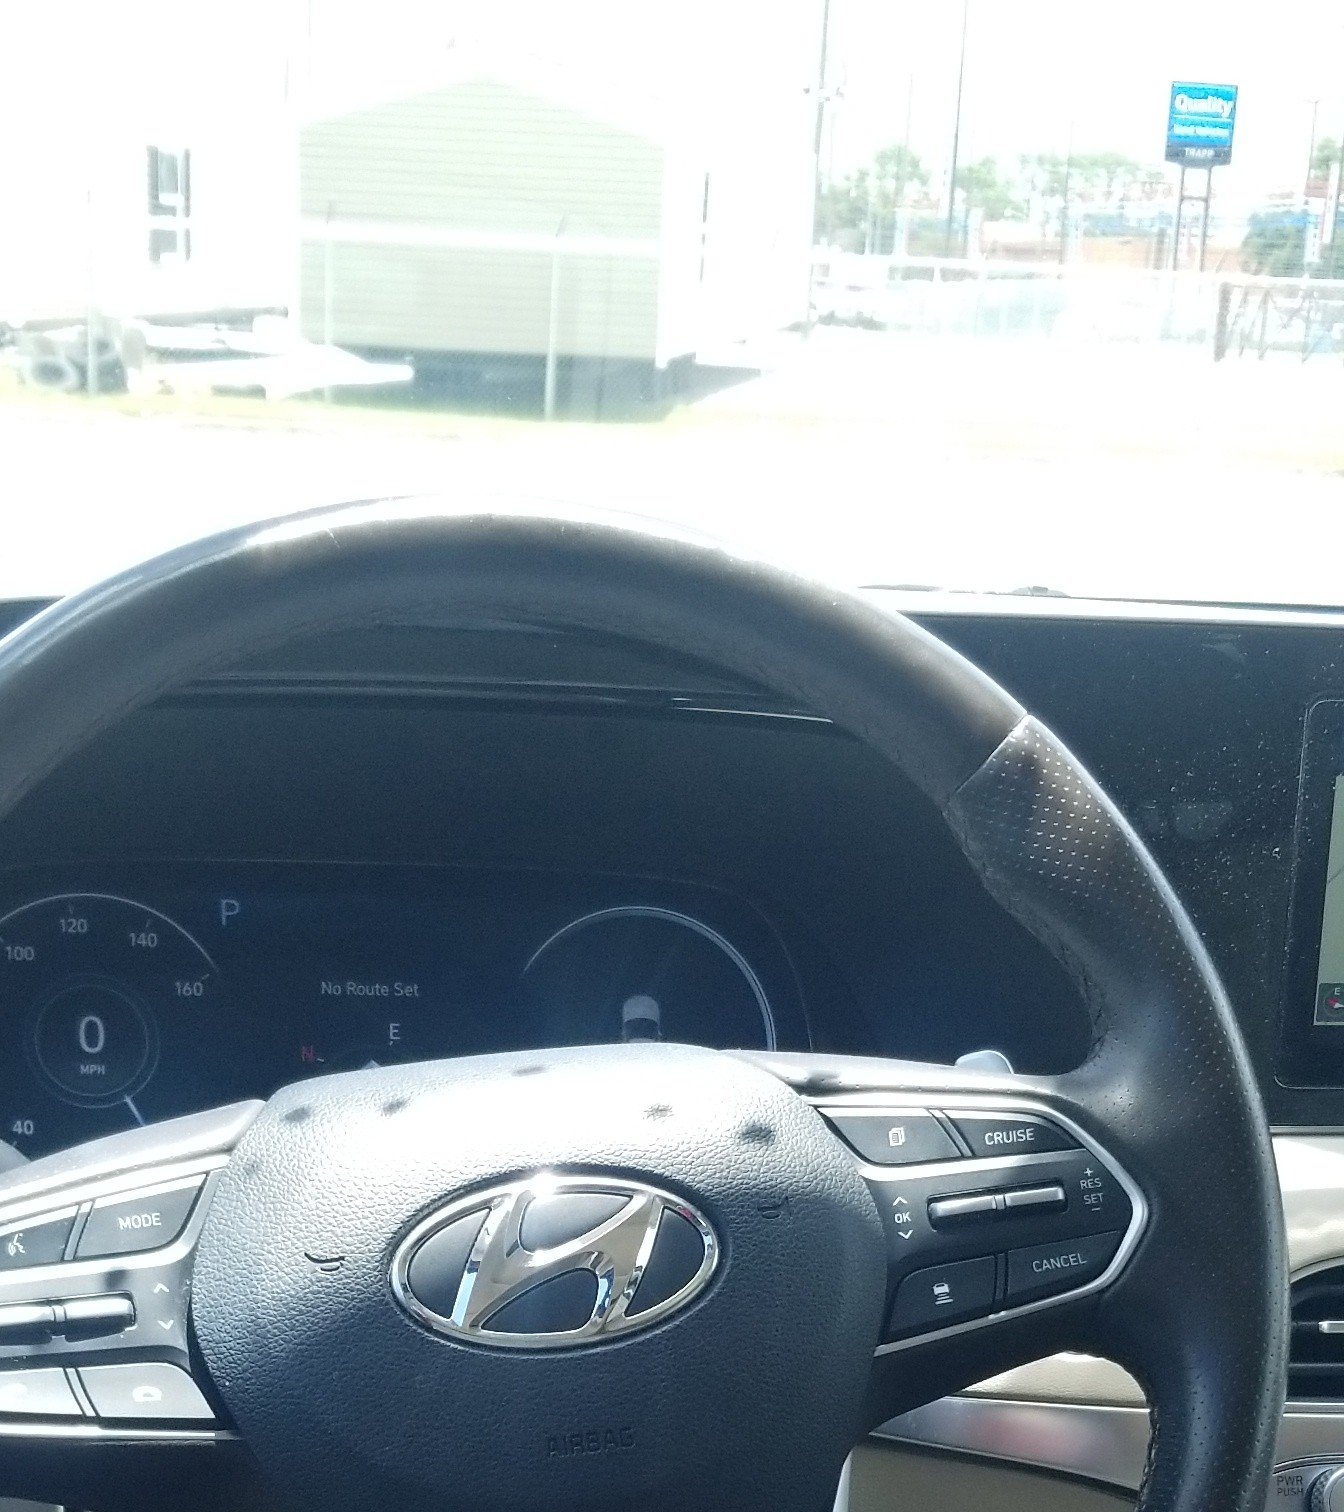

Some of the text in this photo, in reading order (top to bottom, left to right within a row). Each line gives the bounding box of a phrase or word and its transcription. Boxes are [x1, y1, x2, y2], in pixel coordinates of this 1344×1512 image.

[1175, 94, 1233, 118] Quality
[221, 899, 241, 926] P
[59, 919, 88, 933] 120
[129, 933, 157, 948] 140
[6, 946, 35, 962] 100
[175, 982, 204, 997] 160
[321, 981, 419, 996] No Route Set
[78, 1015, 106, 1054] 0
[389, 1023, 401, 1040] E
[79, 1064, 106, 1075] MPH
[12, 1120, 35, 1135] 40
[984, 1128, 1035, 1146] CRUISE
[1080, 1177, 1102, 1190] RES
[1084, 1193, 1104, 1205] SET
[118, 1213, 162, 1230] MODE
[894, 1212, 911, 1224] OK
[1032, 1252, 1087, 1273] CANCEL
[546, 1426, 636, 1458] AIRBAG
[1276, 1475, 1303, 1486] PWR
[1277, 1487, 1305, 1496] PUSH
